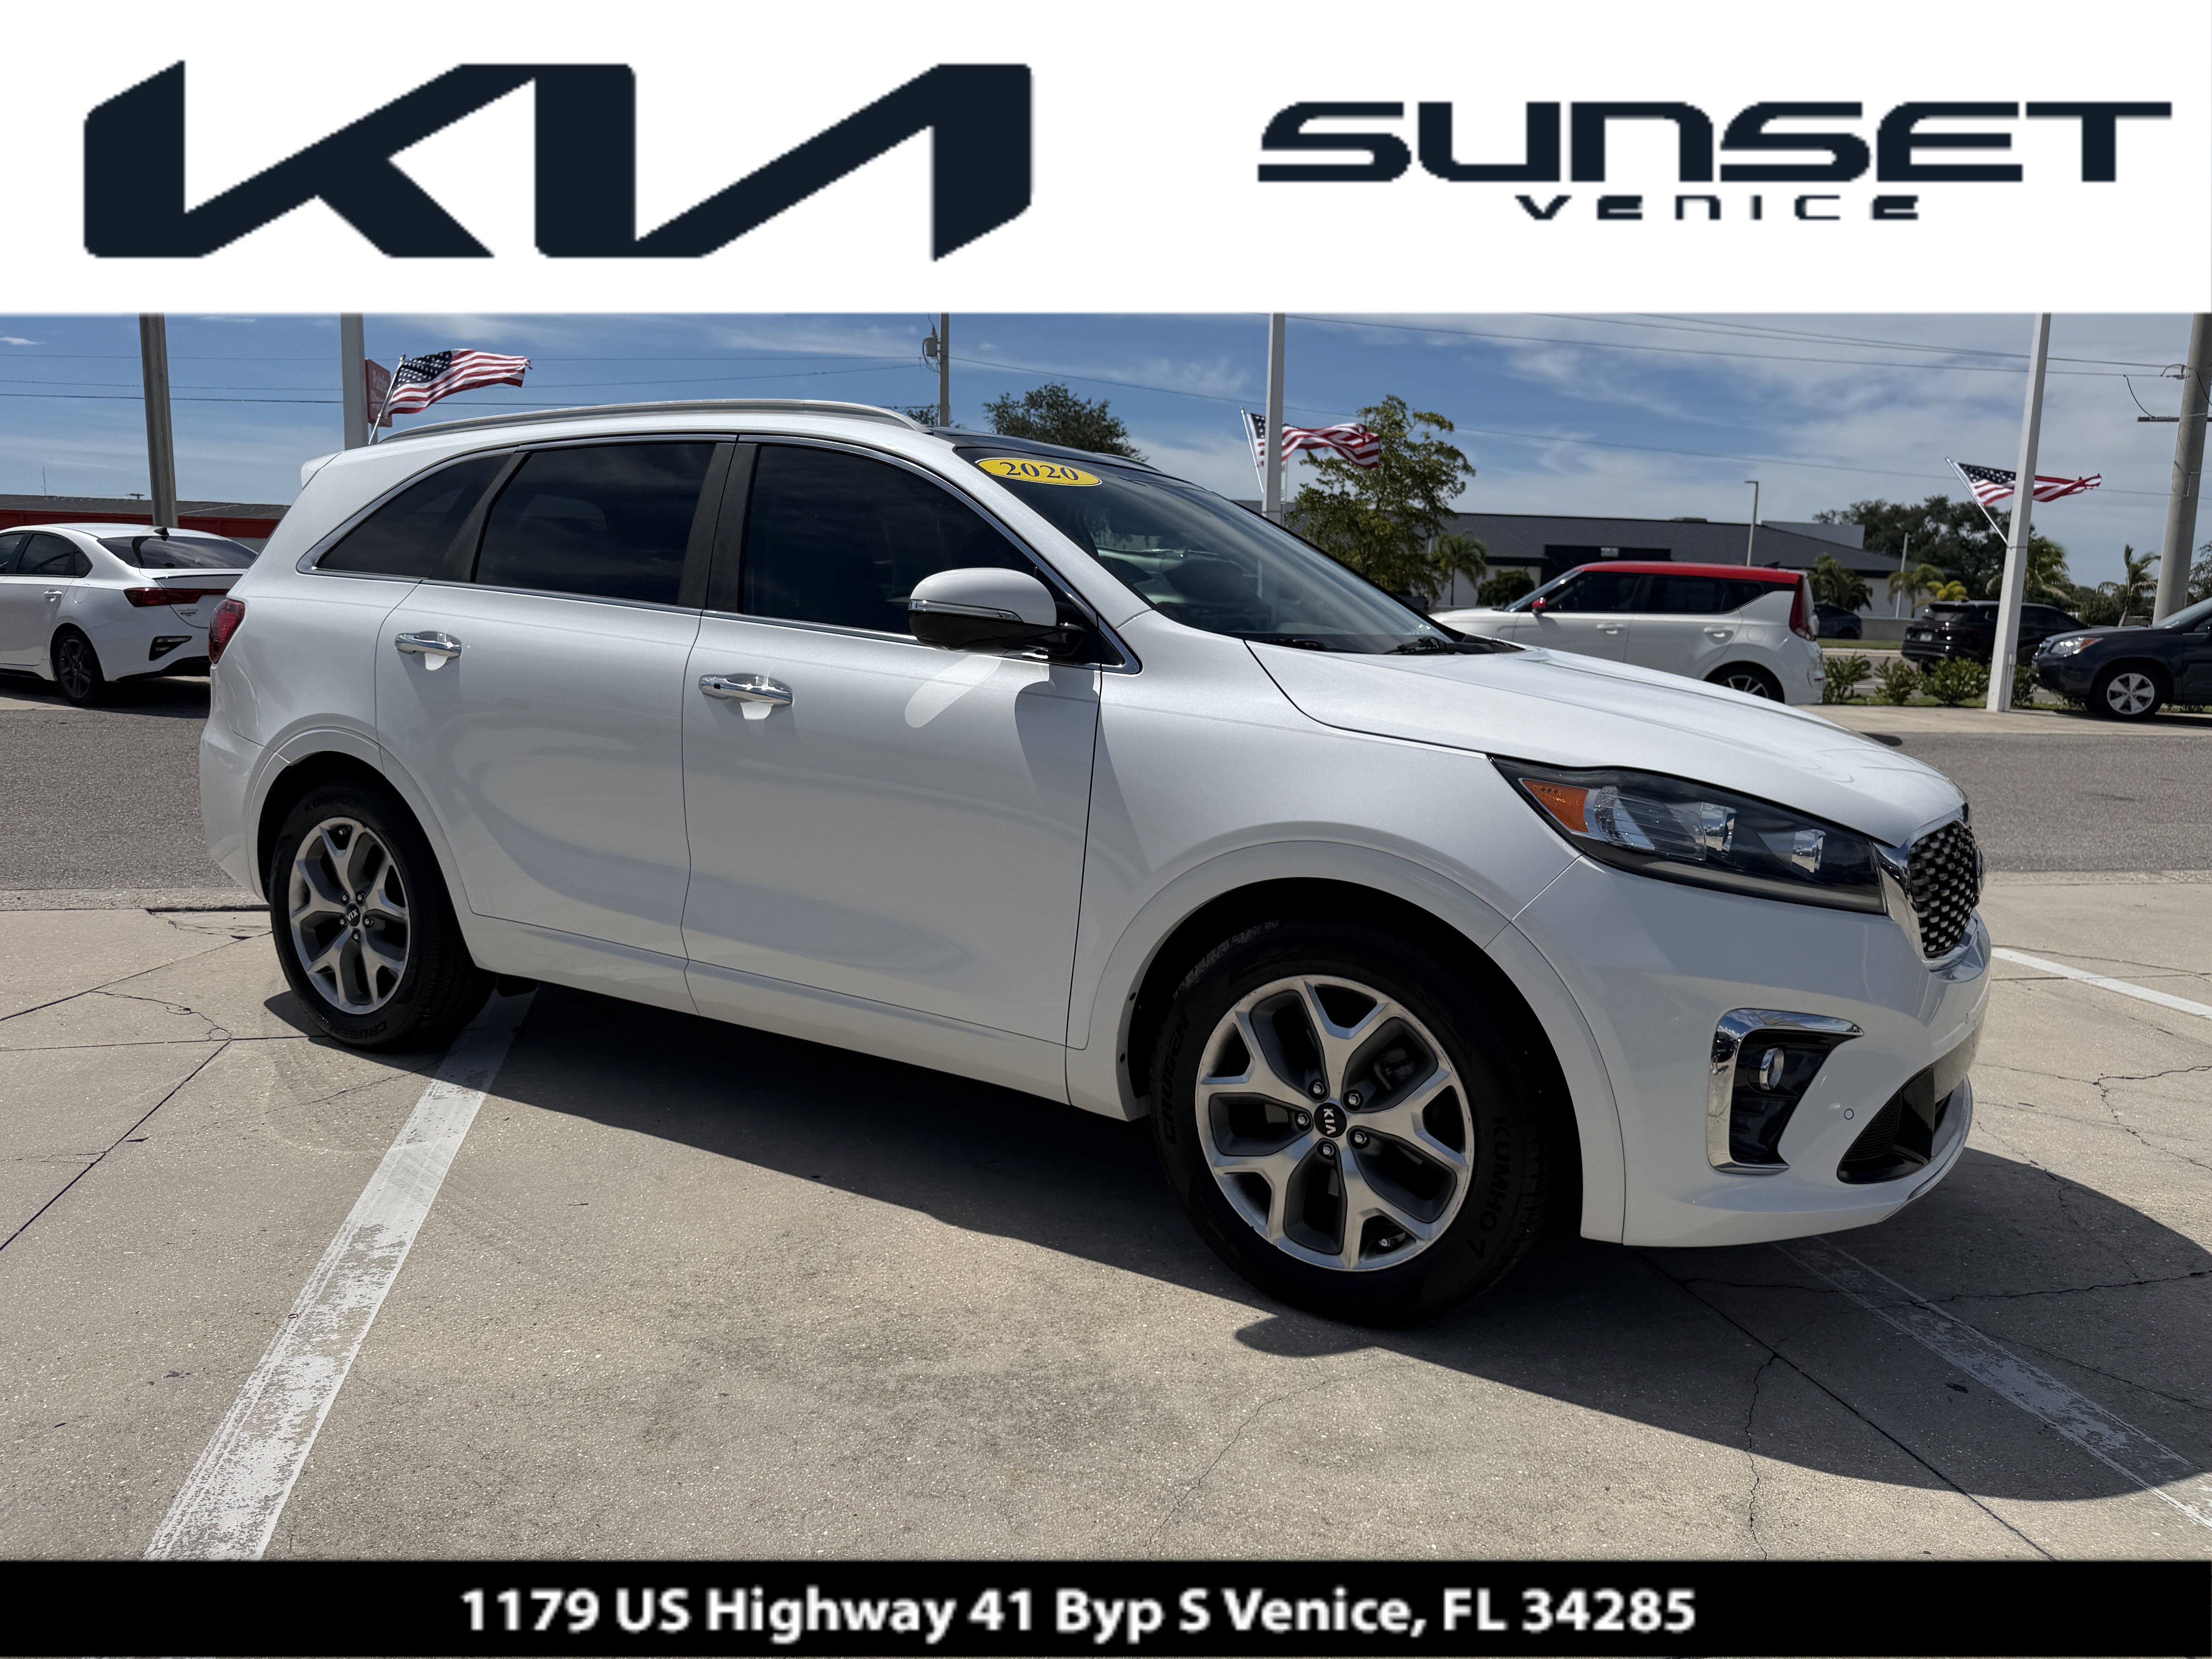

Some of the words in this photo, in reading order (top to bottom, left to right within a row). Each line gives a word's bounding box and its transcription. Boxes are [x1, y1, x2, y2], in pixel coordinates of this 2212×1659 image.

[1000, 462, 1079, 481] 2020
[347, 908, 358, 921] KIA
[1161, 1011, 1190, 1145] CRUGEN
[1323, 1108, 1336, 1135] KIA
[1479, 1117, 1511, 1232] KUMHO
